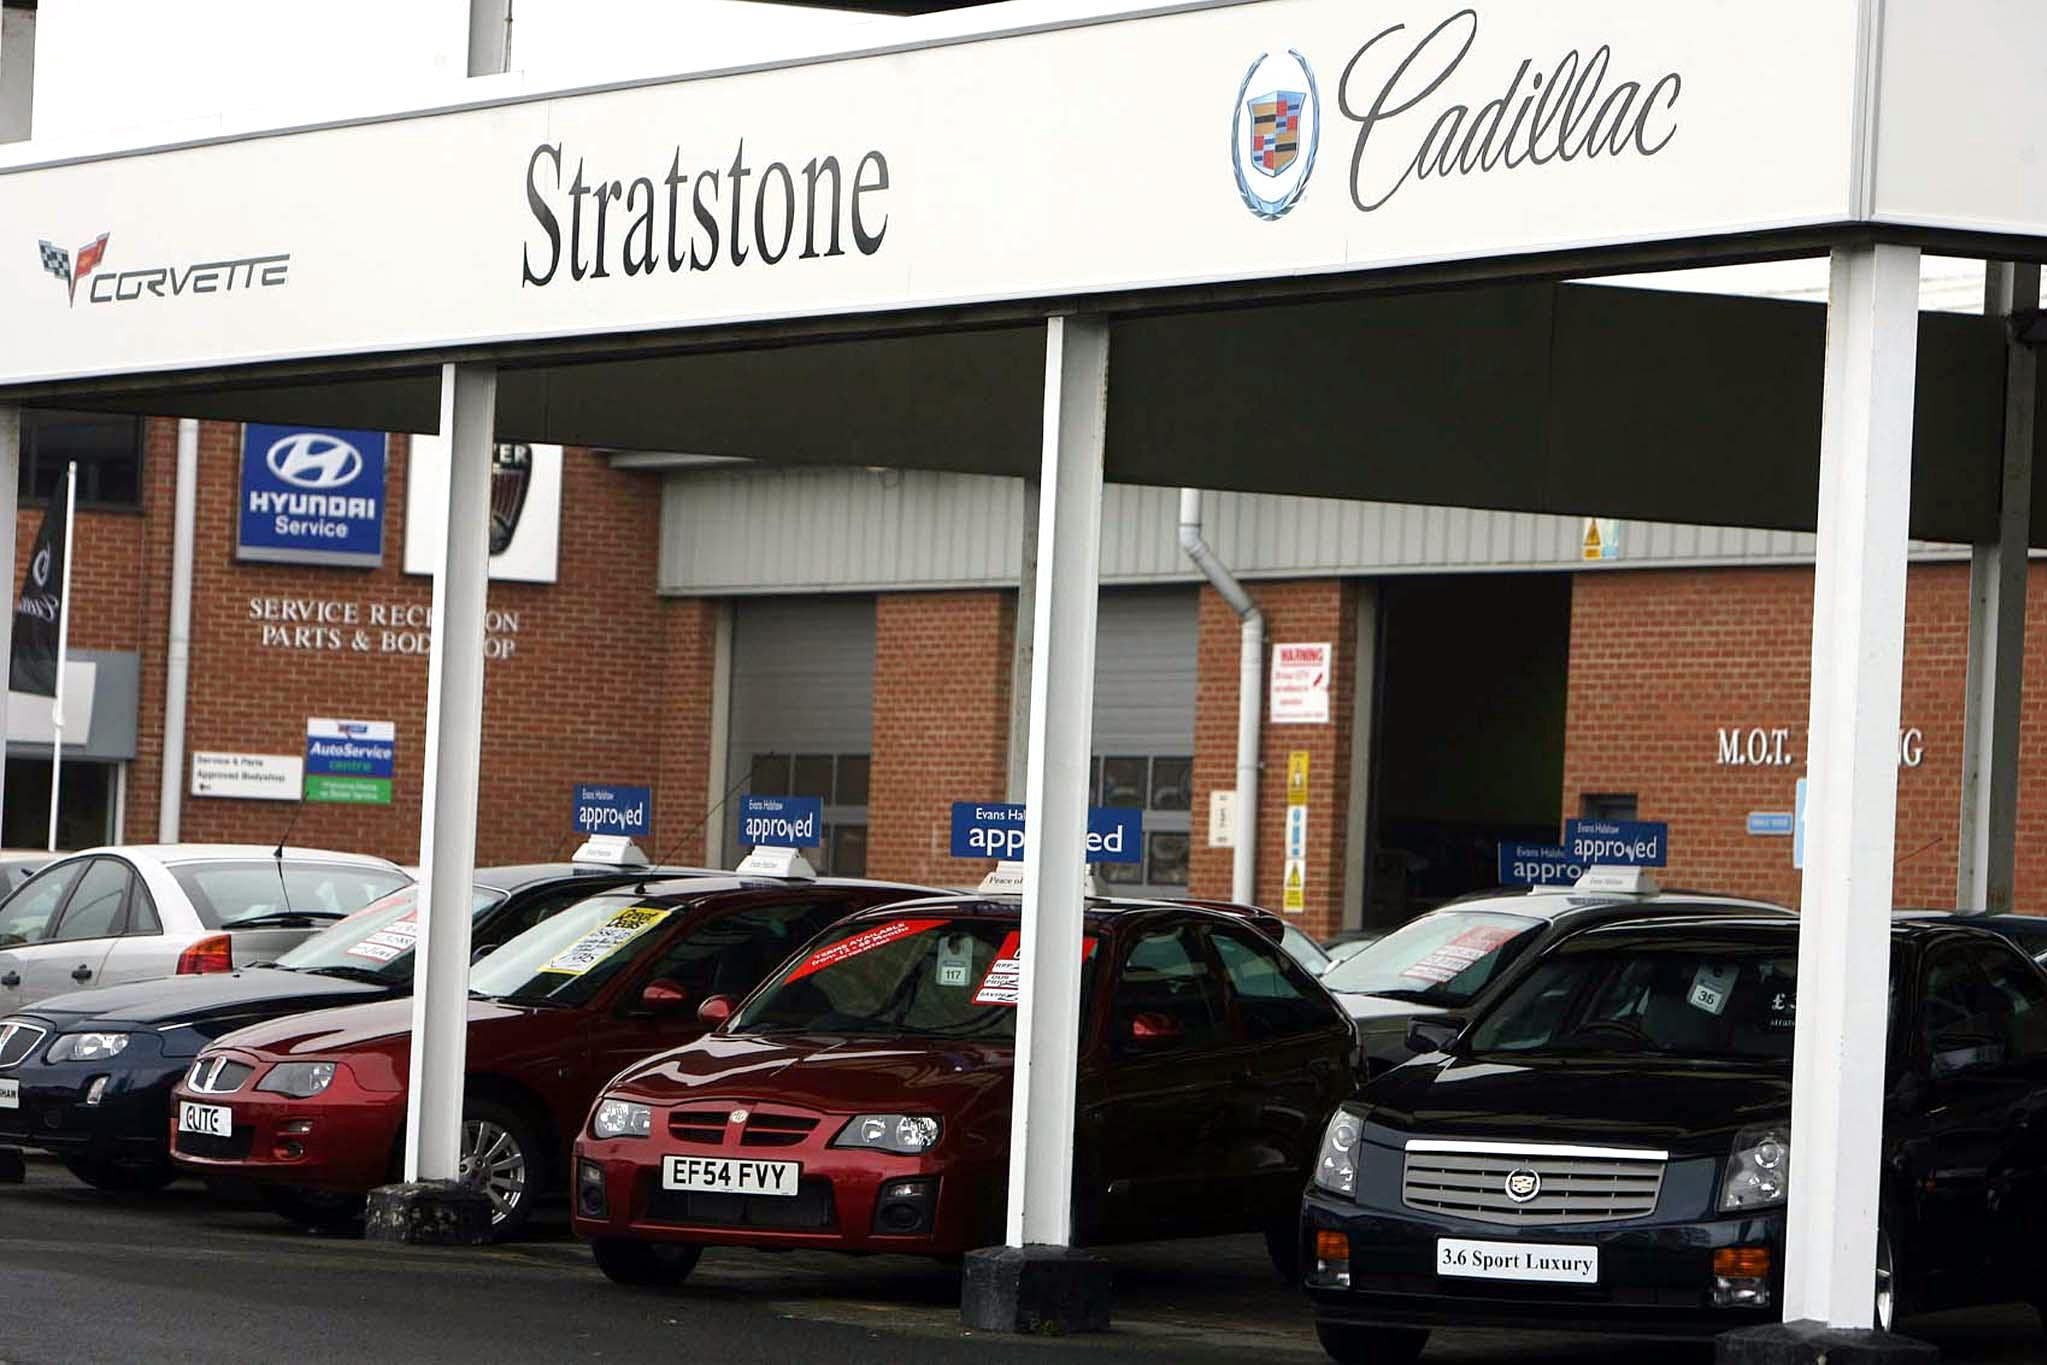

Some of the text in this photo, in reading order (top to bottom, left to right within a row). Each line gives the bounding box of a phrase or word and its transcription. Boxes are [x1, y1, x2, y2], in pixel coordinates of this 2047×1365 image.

[1338, 8, 1682, 212] Cadillac
[522, 137, 890, 289] Stratstone
[90, 253, 291, 303] CORVETTE
[250, 490, 376, 519] HYUNDAI
[274, 516, 348, 538] Service
[249, 597, 359, 625] SERVICE
[261, 624, 342, 651] PARTS
[351, 631, 371, 651] &
[310, 741, 392, 760] AutoService
[1717, 727, 1792, 766] M.O.T.
[579, 802, 642, 831] approved
[746, 812, 813, 843] approved
[976, 807, 1005, 820] Evans
[1574, 836, 1657, 863] approved
[946, 970, 961, 980] 117
[186, 1106, 219, 1132] ELITE
[673, 1159, 786, 1189] EF54 FVY
[1442, 1248, 1593, 1276] 3.6 Sport Luxury
